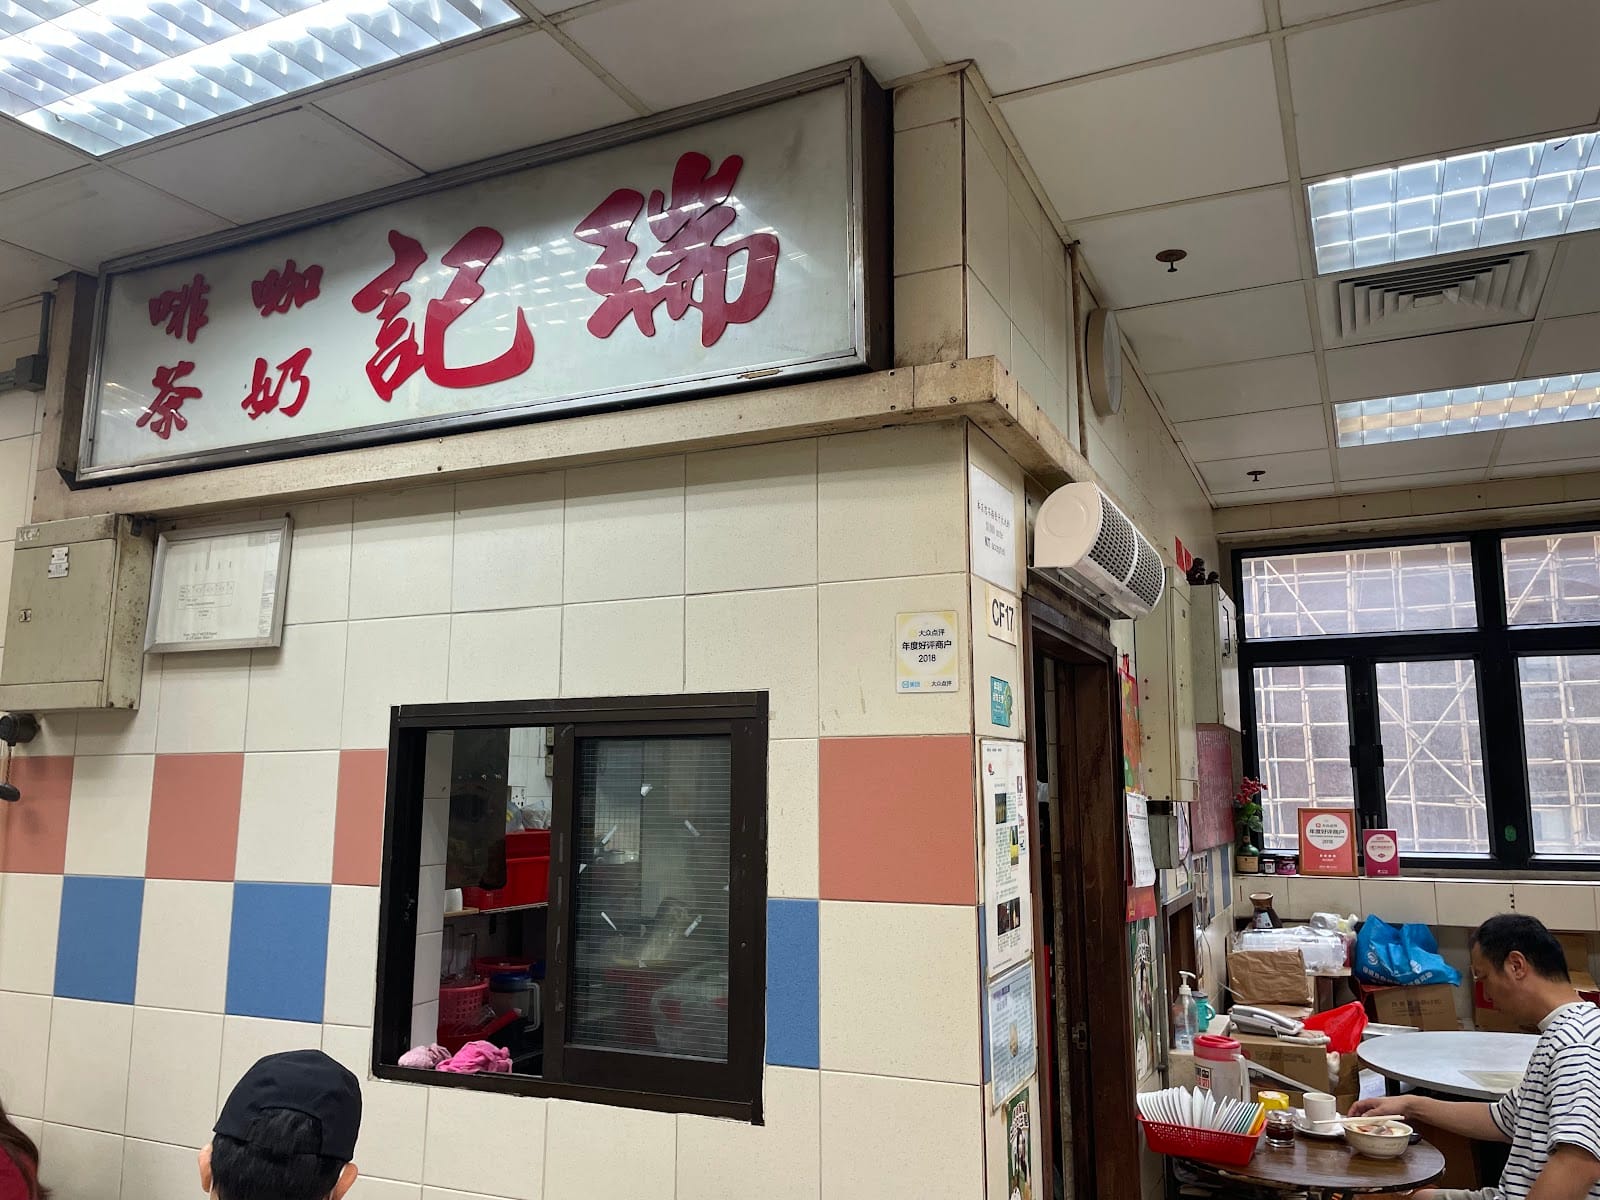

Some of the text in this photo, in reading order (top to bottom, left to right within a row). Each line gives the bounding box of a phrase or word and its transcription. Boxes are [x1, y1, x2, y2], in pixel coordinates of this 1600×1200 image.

[992, 598, 1014, 632] CF17
[918, 629, 945, 637] 大众点评
[902, 639, 952, 651] 年度好评商户
[918, 654, 937, 663] 2018
